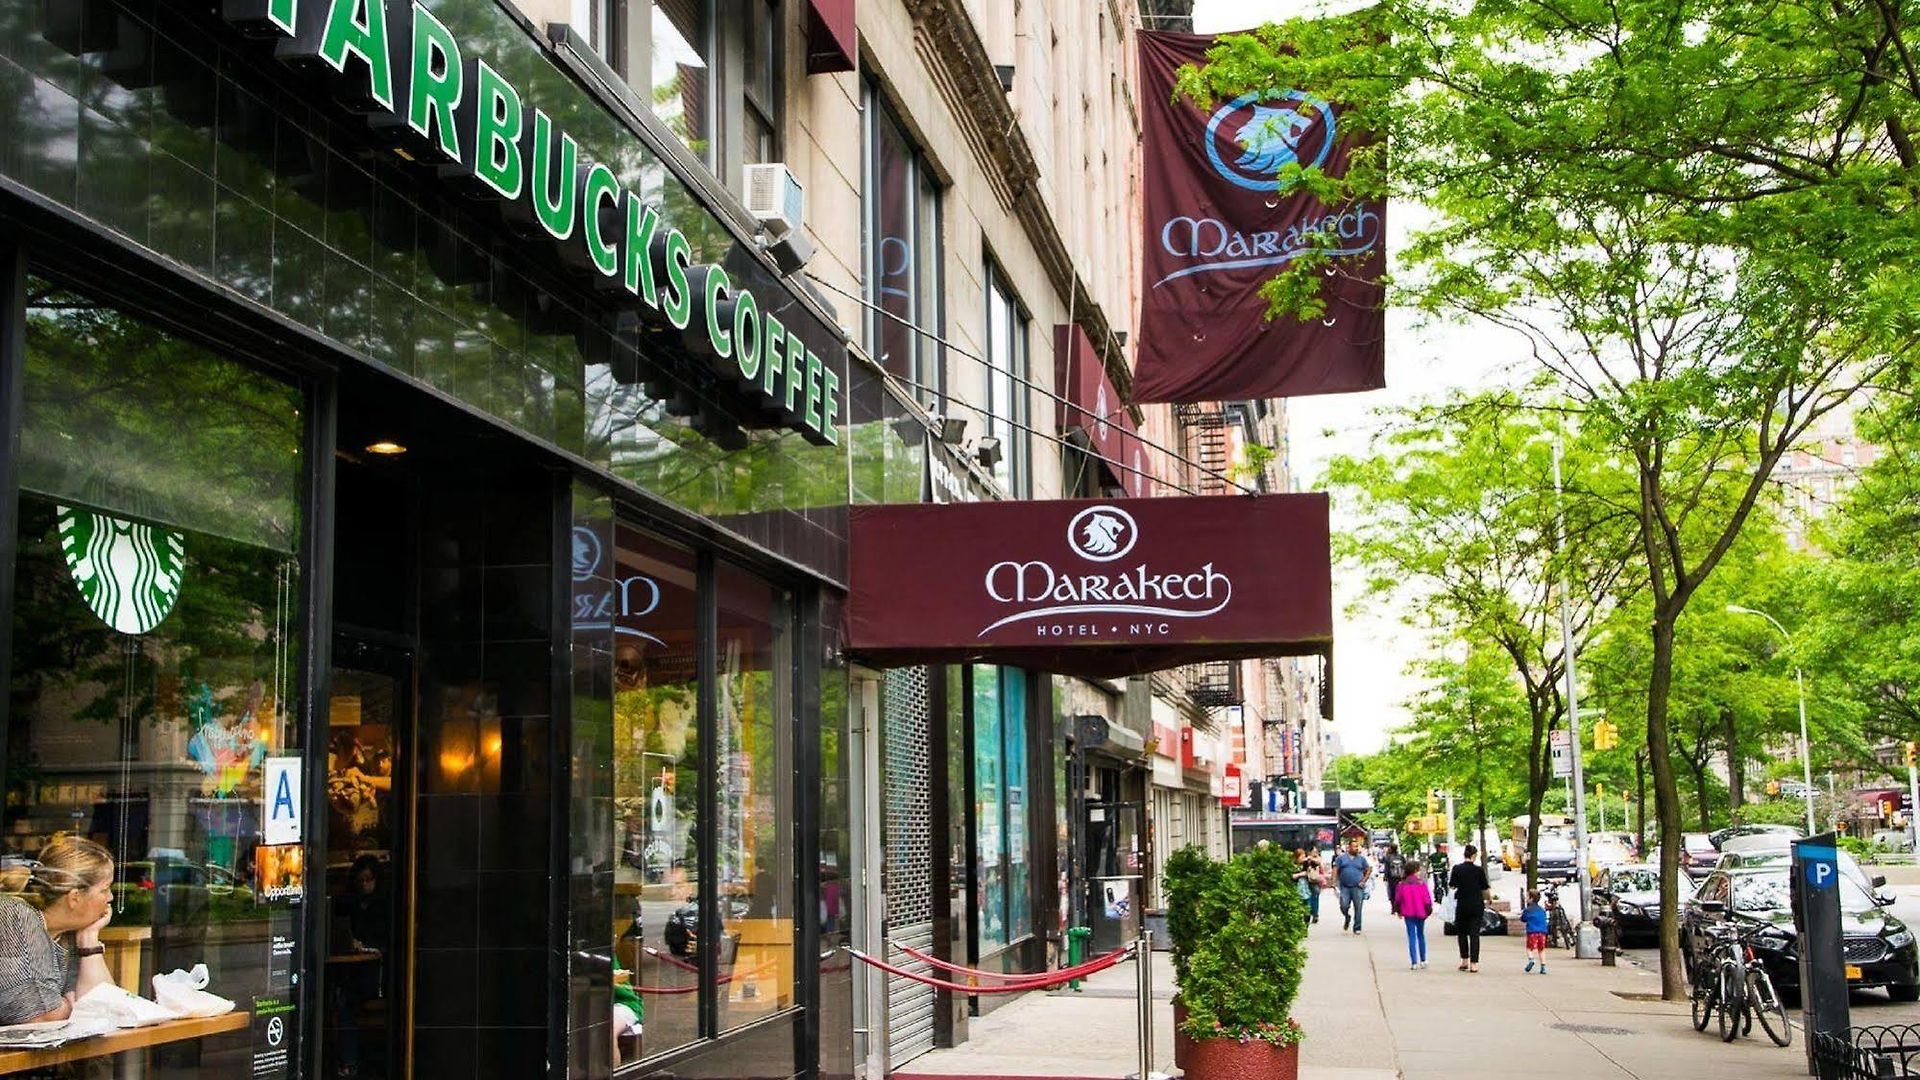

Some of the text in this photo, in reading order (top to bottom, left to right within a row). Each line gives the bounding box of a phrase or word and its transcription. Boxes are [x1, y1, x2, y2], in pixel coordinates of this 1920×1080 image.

[268, 0, 838, 446] ARBUCKS COFFEE
[985, 561, 1232, 604] Marrakech
[1037, 623, 1169, 636] HOTEL NYC
[272, 769, 295, 820] A
[1816, 863, 1831, 884] P
